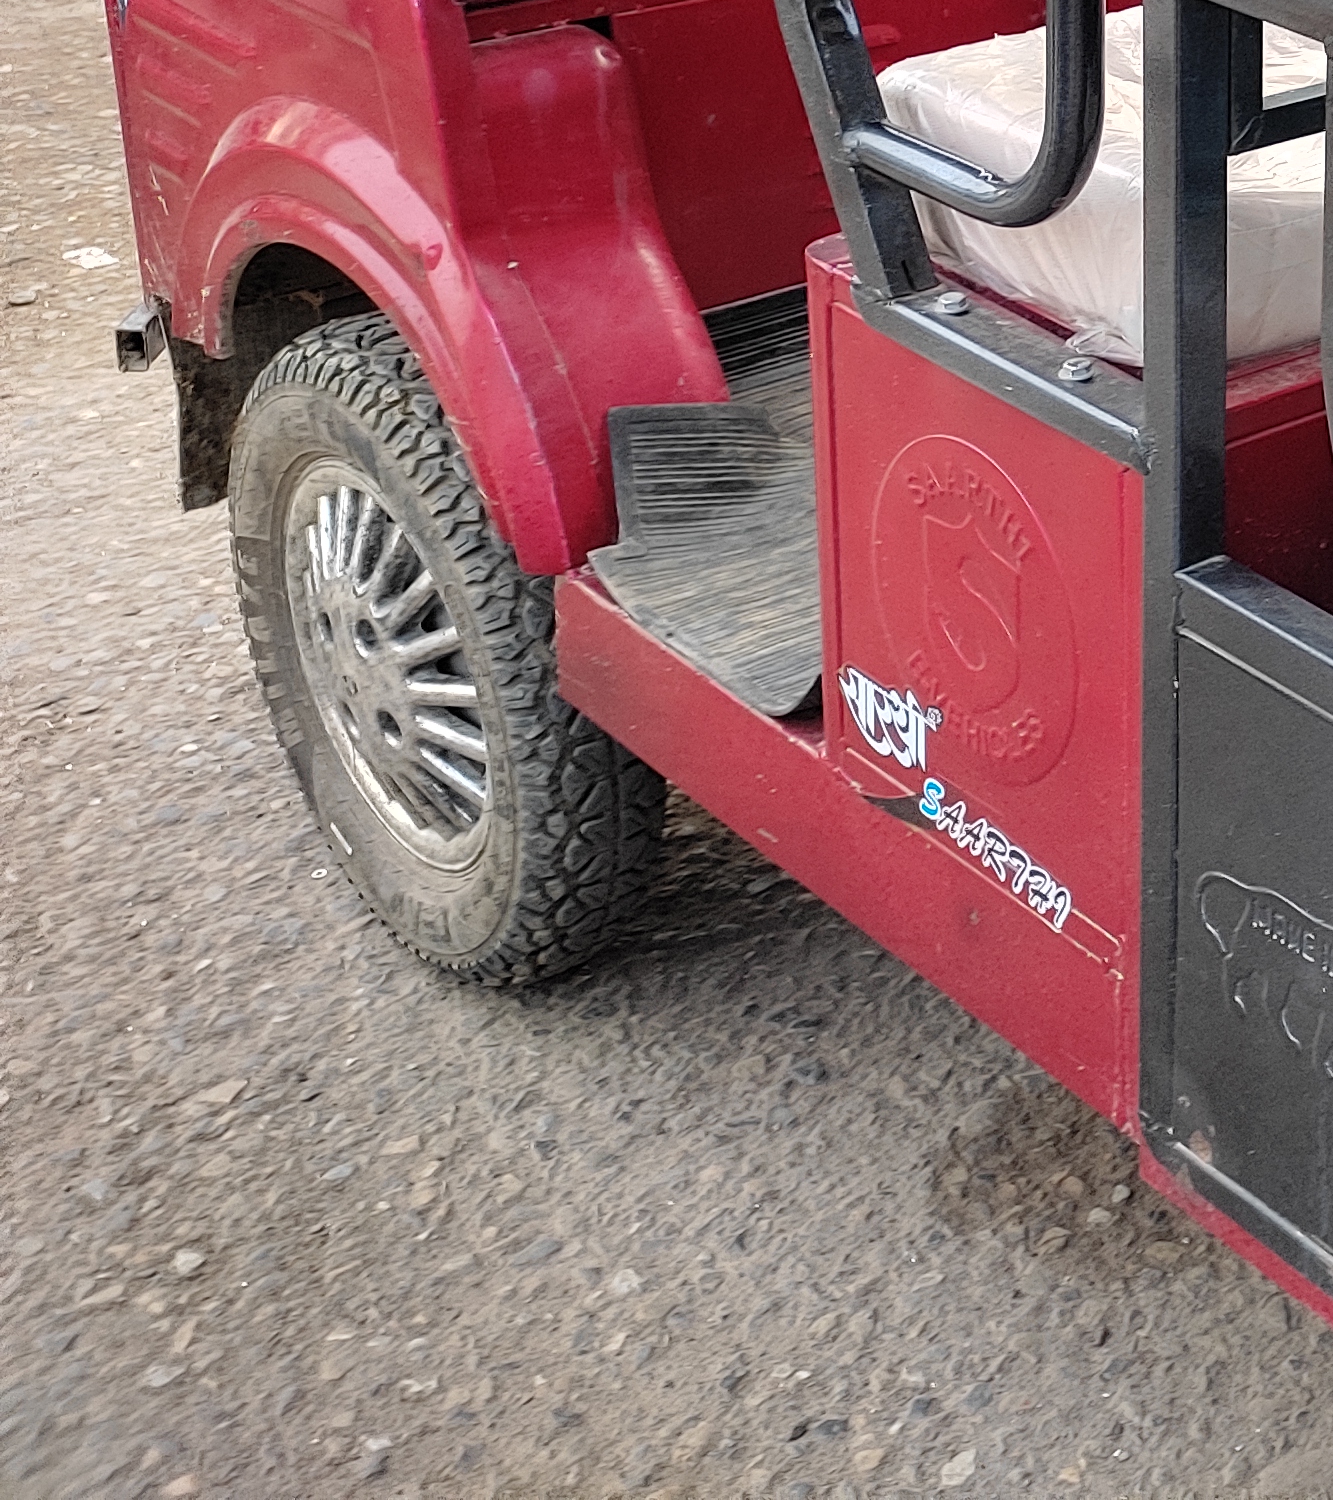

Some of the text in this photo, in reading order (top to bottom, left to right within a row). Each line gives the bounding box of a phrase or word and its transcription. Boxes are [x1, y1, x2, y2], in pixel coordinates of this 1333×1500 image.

[838, 665, 937, 773] सारथी
[919, 777, 1072, 929] SAARTHI
[1250, 899, 1317, 964] MADE
